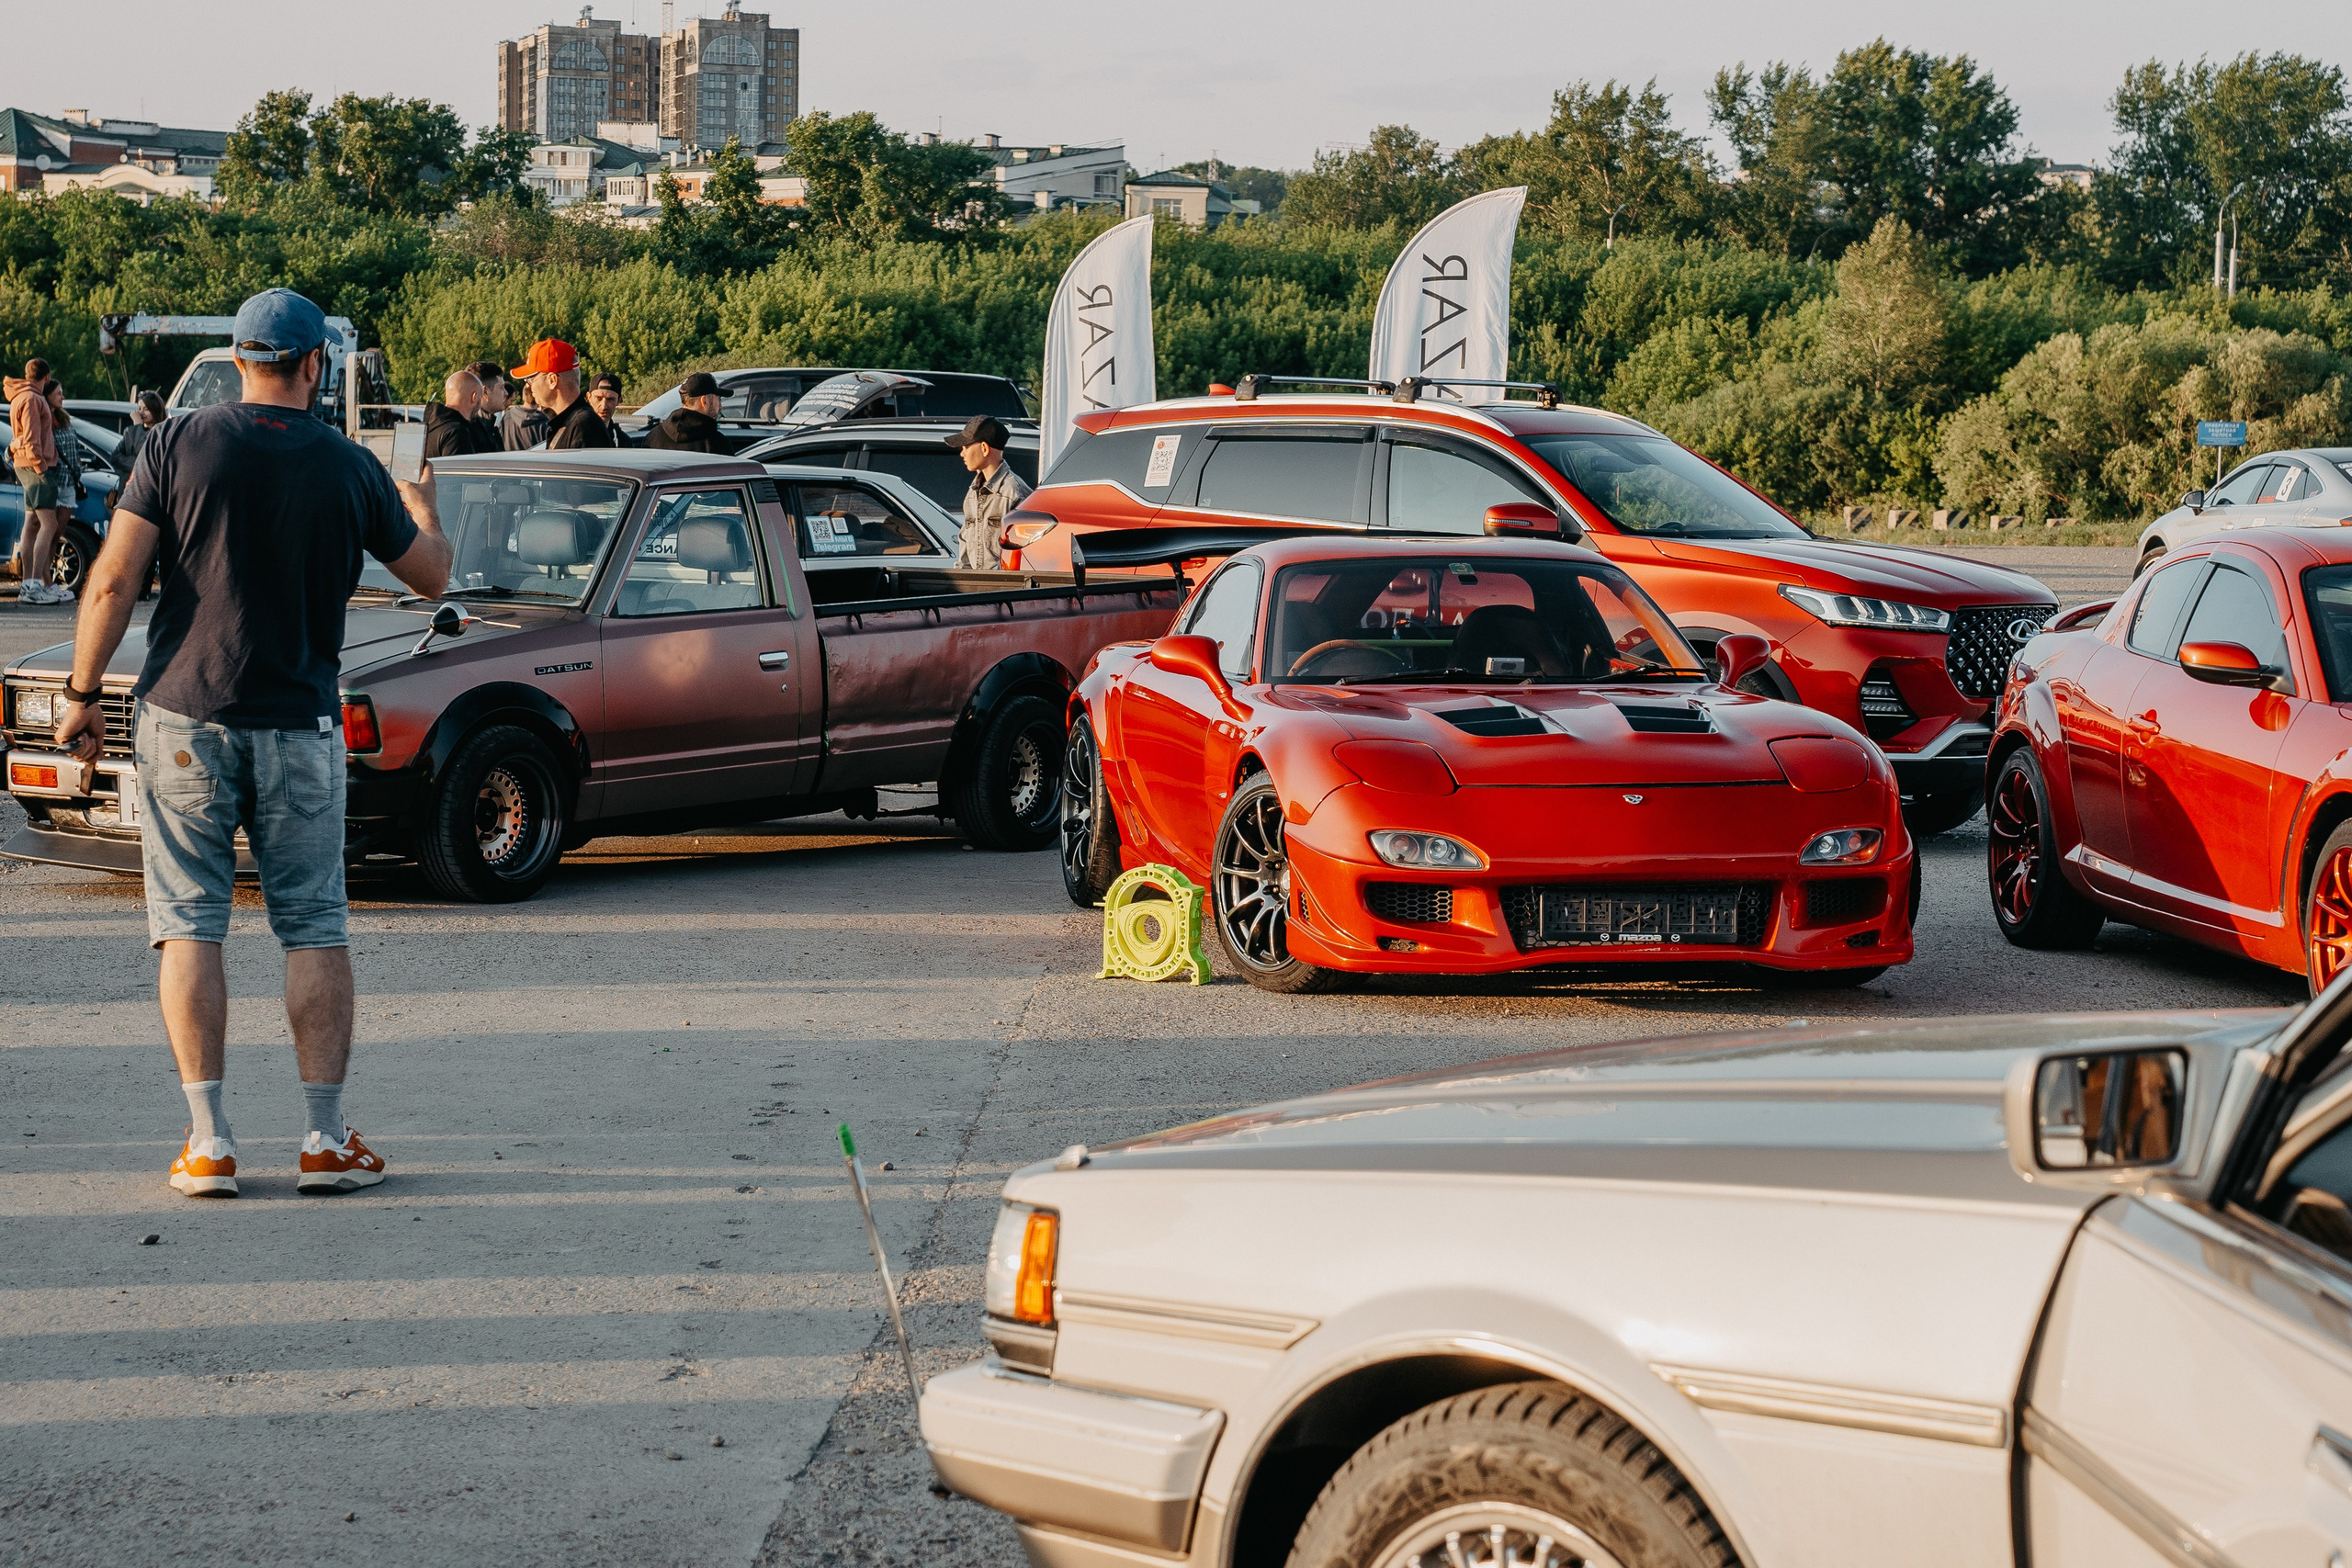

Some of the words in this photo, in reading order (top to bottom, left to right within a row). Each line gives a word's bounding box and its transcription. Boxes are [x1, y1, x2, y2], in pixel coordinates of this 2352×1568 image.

[2281, 477, 2293, 496] 3
[815, 544, 854, 552] Telegram
[537, 663, 593, 674] DATSUN
